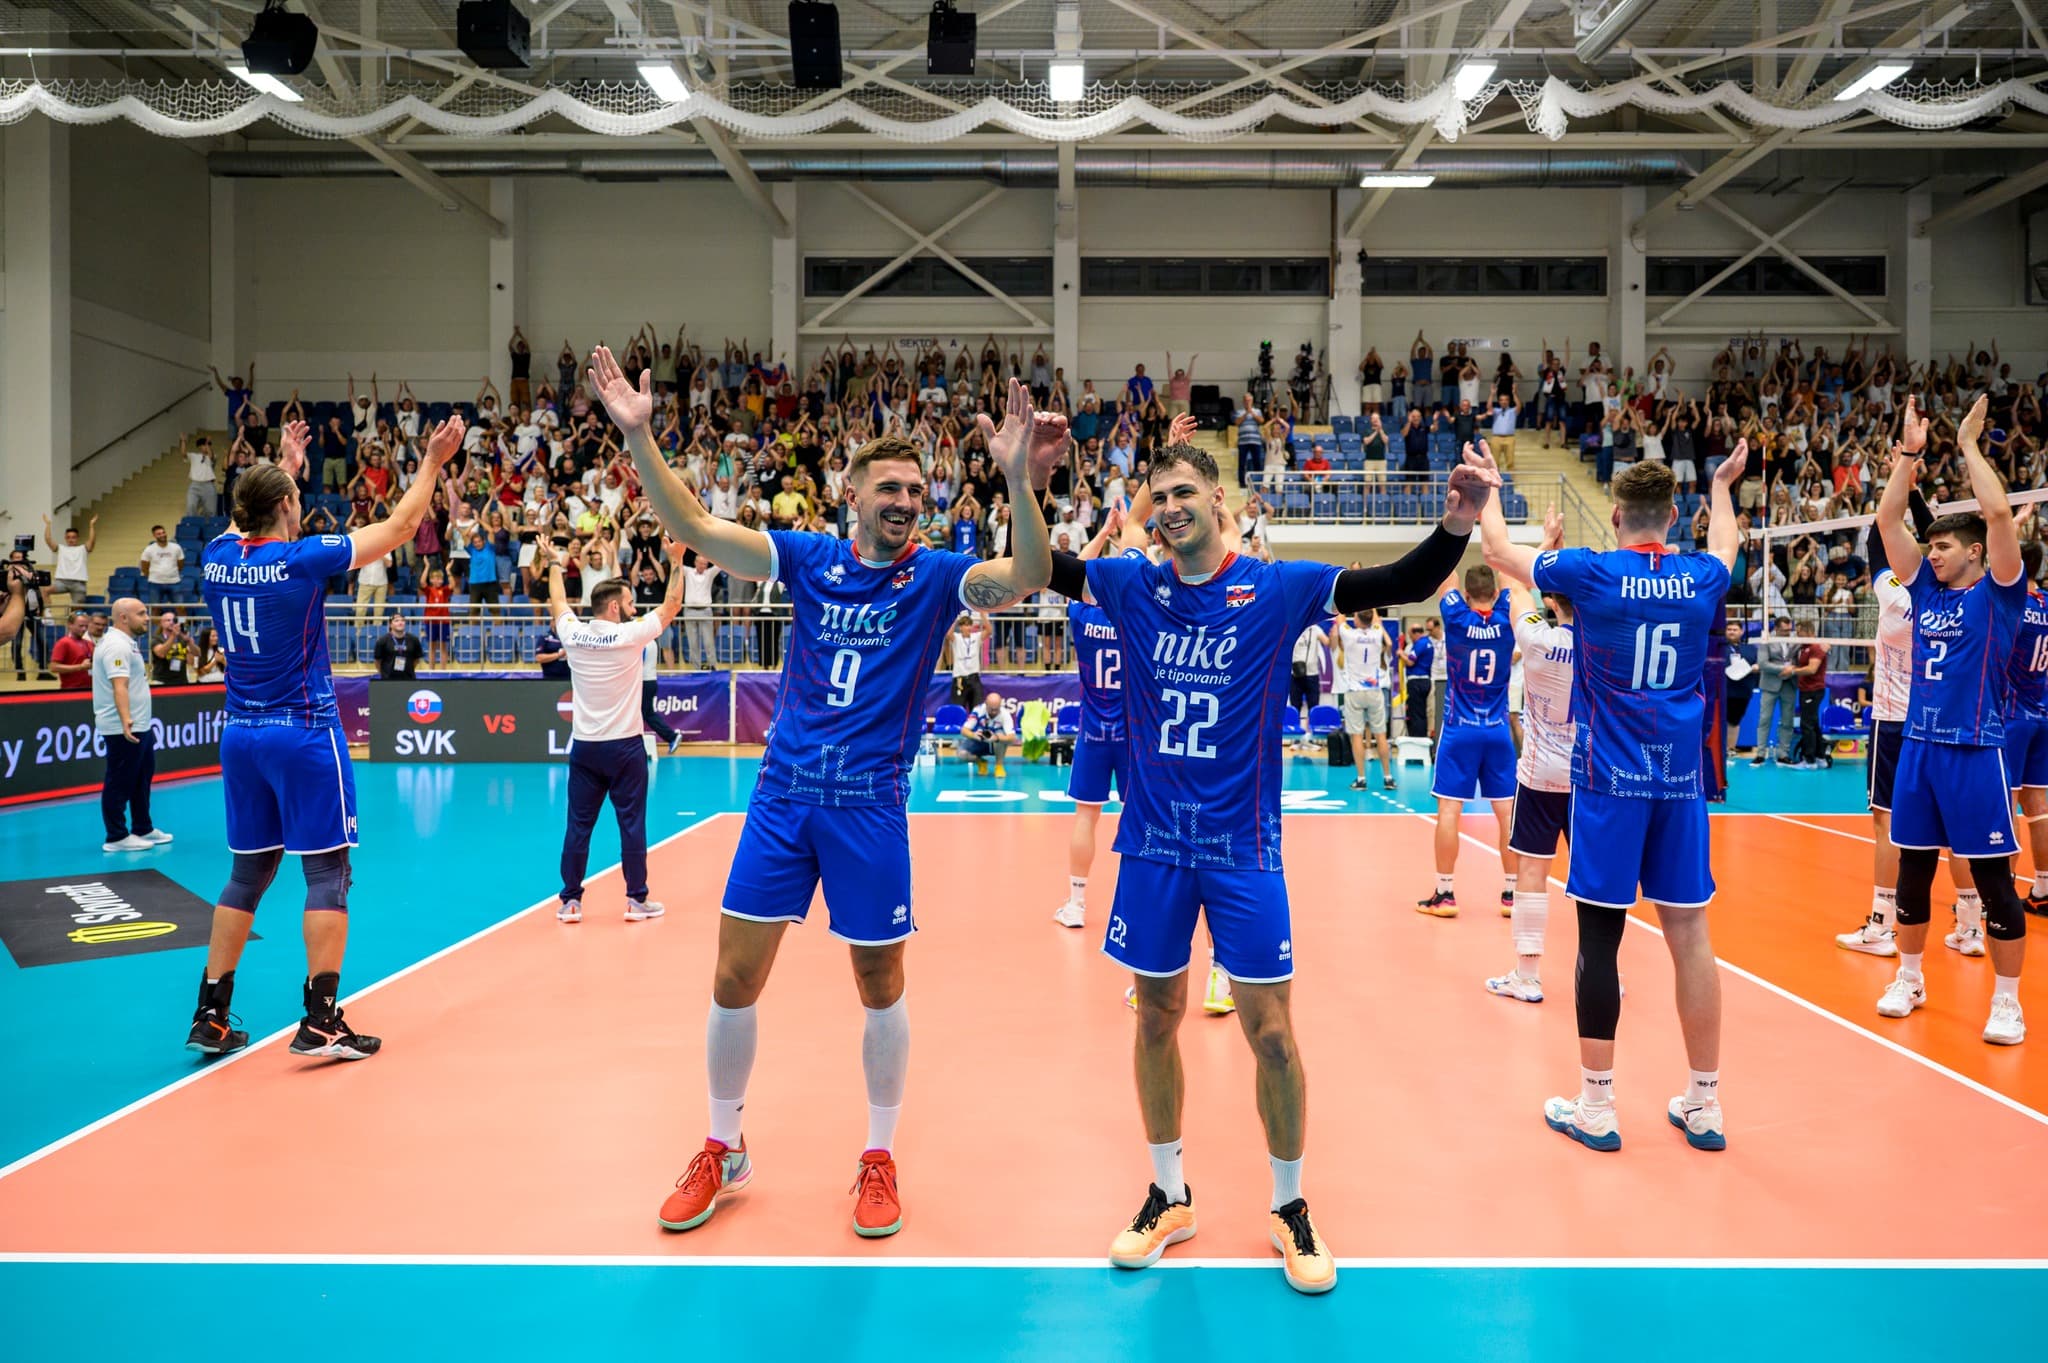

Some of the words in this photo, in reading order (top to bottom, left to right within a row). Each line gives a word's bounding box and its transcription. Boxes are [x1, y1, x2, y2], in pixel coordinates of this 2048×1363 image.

[900, 339, 938, 348] SEKTO
[950, 339, 957, 348] A
[1502, 339, 1509, 347] C
[1621, 572, 1696, 599] KOVÁČ
[222, 596, 260, 654] 14
[820, 601, 898, 634] niké
[1466, 623, 1502, 639] IHNÁT
[817, 629, 832, 641] je
[833, 633, 891, 647] tipovanie
[1153, 625, 1237, 670] niké
[1096, 648, 1121, 689] 12
[1468, 648, 1496, 685] 13
[1632, 623, 1680, 690] 16
[1925, 639, 1947, 680] 2
[827, 648, 862, 707] 9
[1154, 665, 1166, 680] je
[1168, 668, 1231, 685] tipovanie
[483, 714, 516, 734] VS
[1159, 688, 1219, 759] 22
[35, 723, 107, 764] 2026
[395, 729, 456, 755] SVK
[348, 815, 357, 833] 14
[1109, 914, 1127, 949] 22
